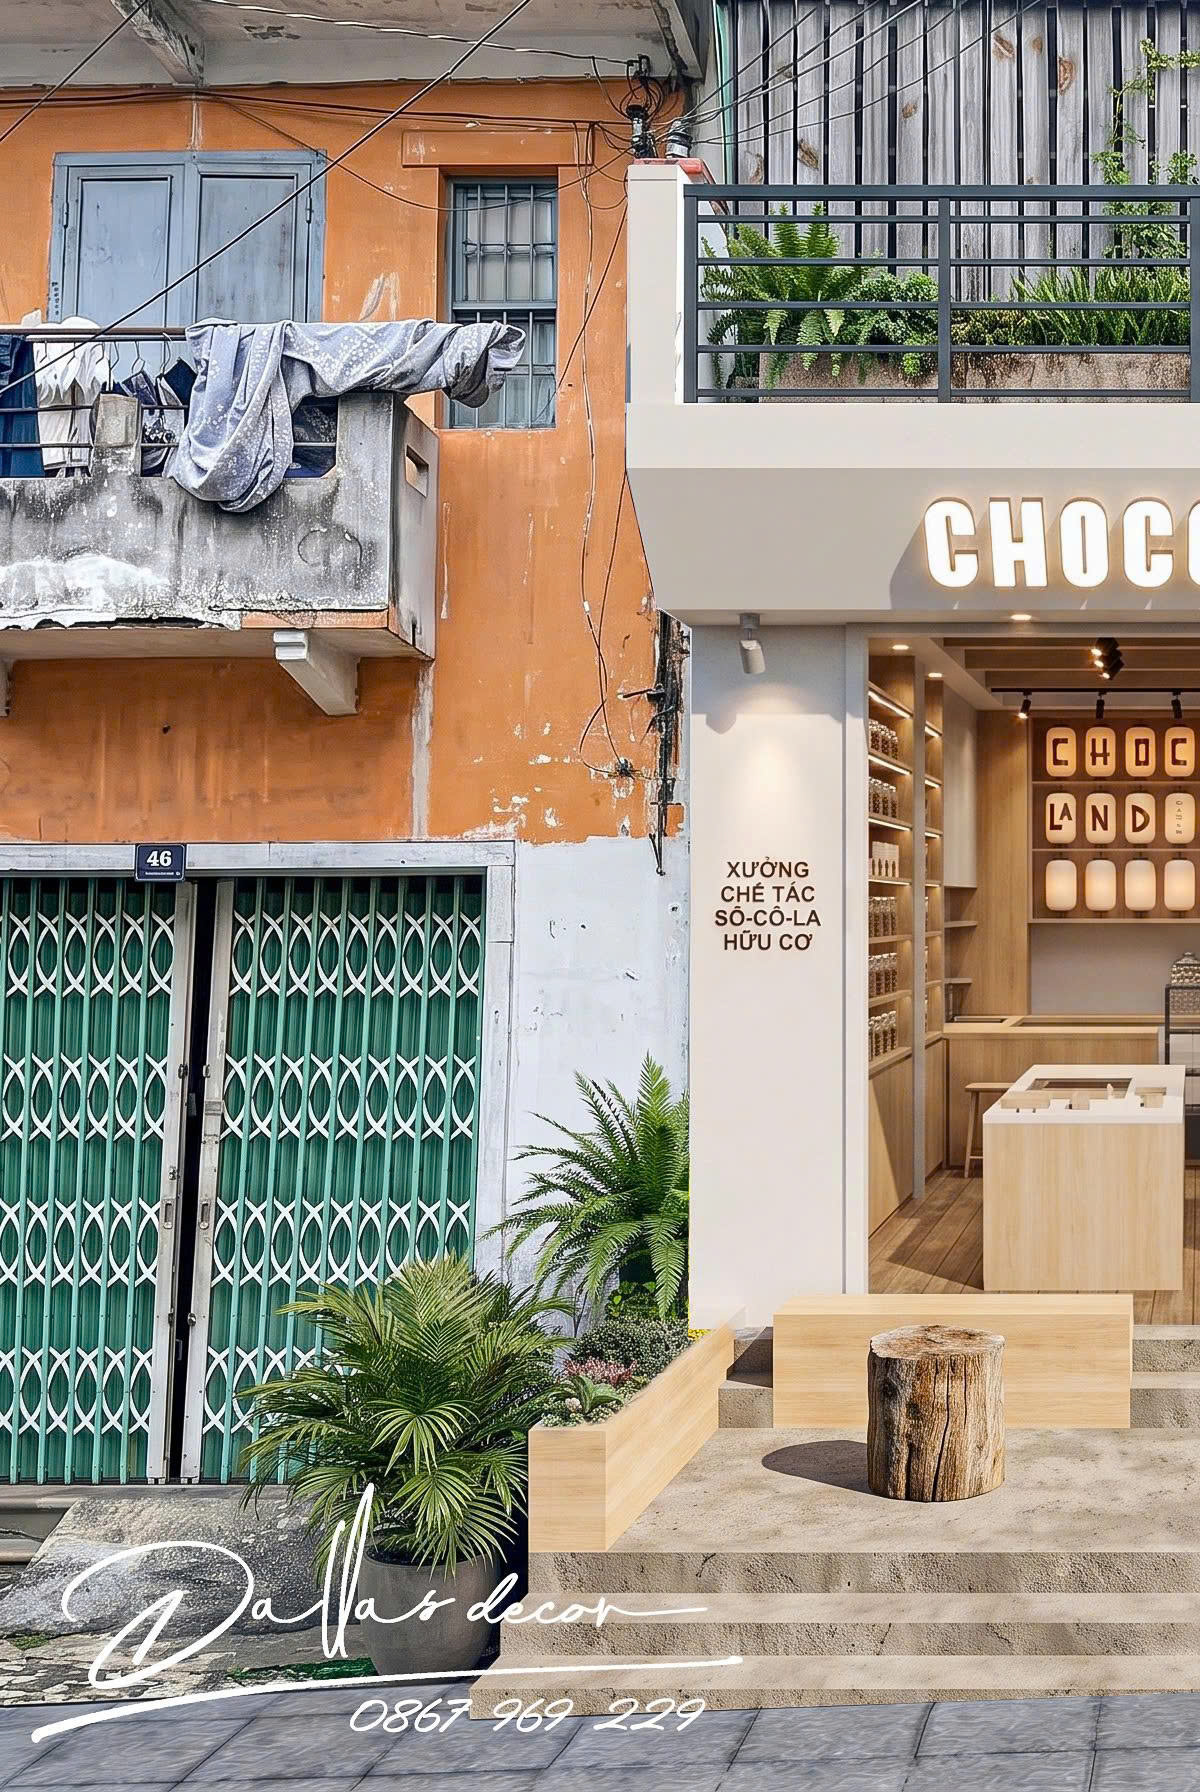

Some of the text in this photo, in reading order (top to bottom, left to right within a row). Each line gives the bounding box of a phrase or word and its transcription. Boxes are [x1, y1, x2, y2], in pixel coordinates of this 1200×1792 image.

[1049, 802, 1151, 833] LAND
[146, 850, 172, 867] 46
[726, 856, 810, 878] XƯỞNG
[772, 881, 816, 903] TÁC
[714, 905, 822, 927] SÔ-CÔ-LA
[724, 929, 813, 951] HỮU CƠ
